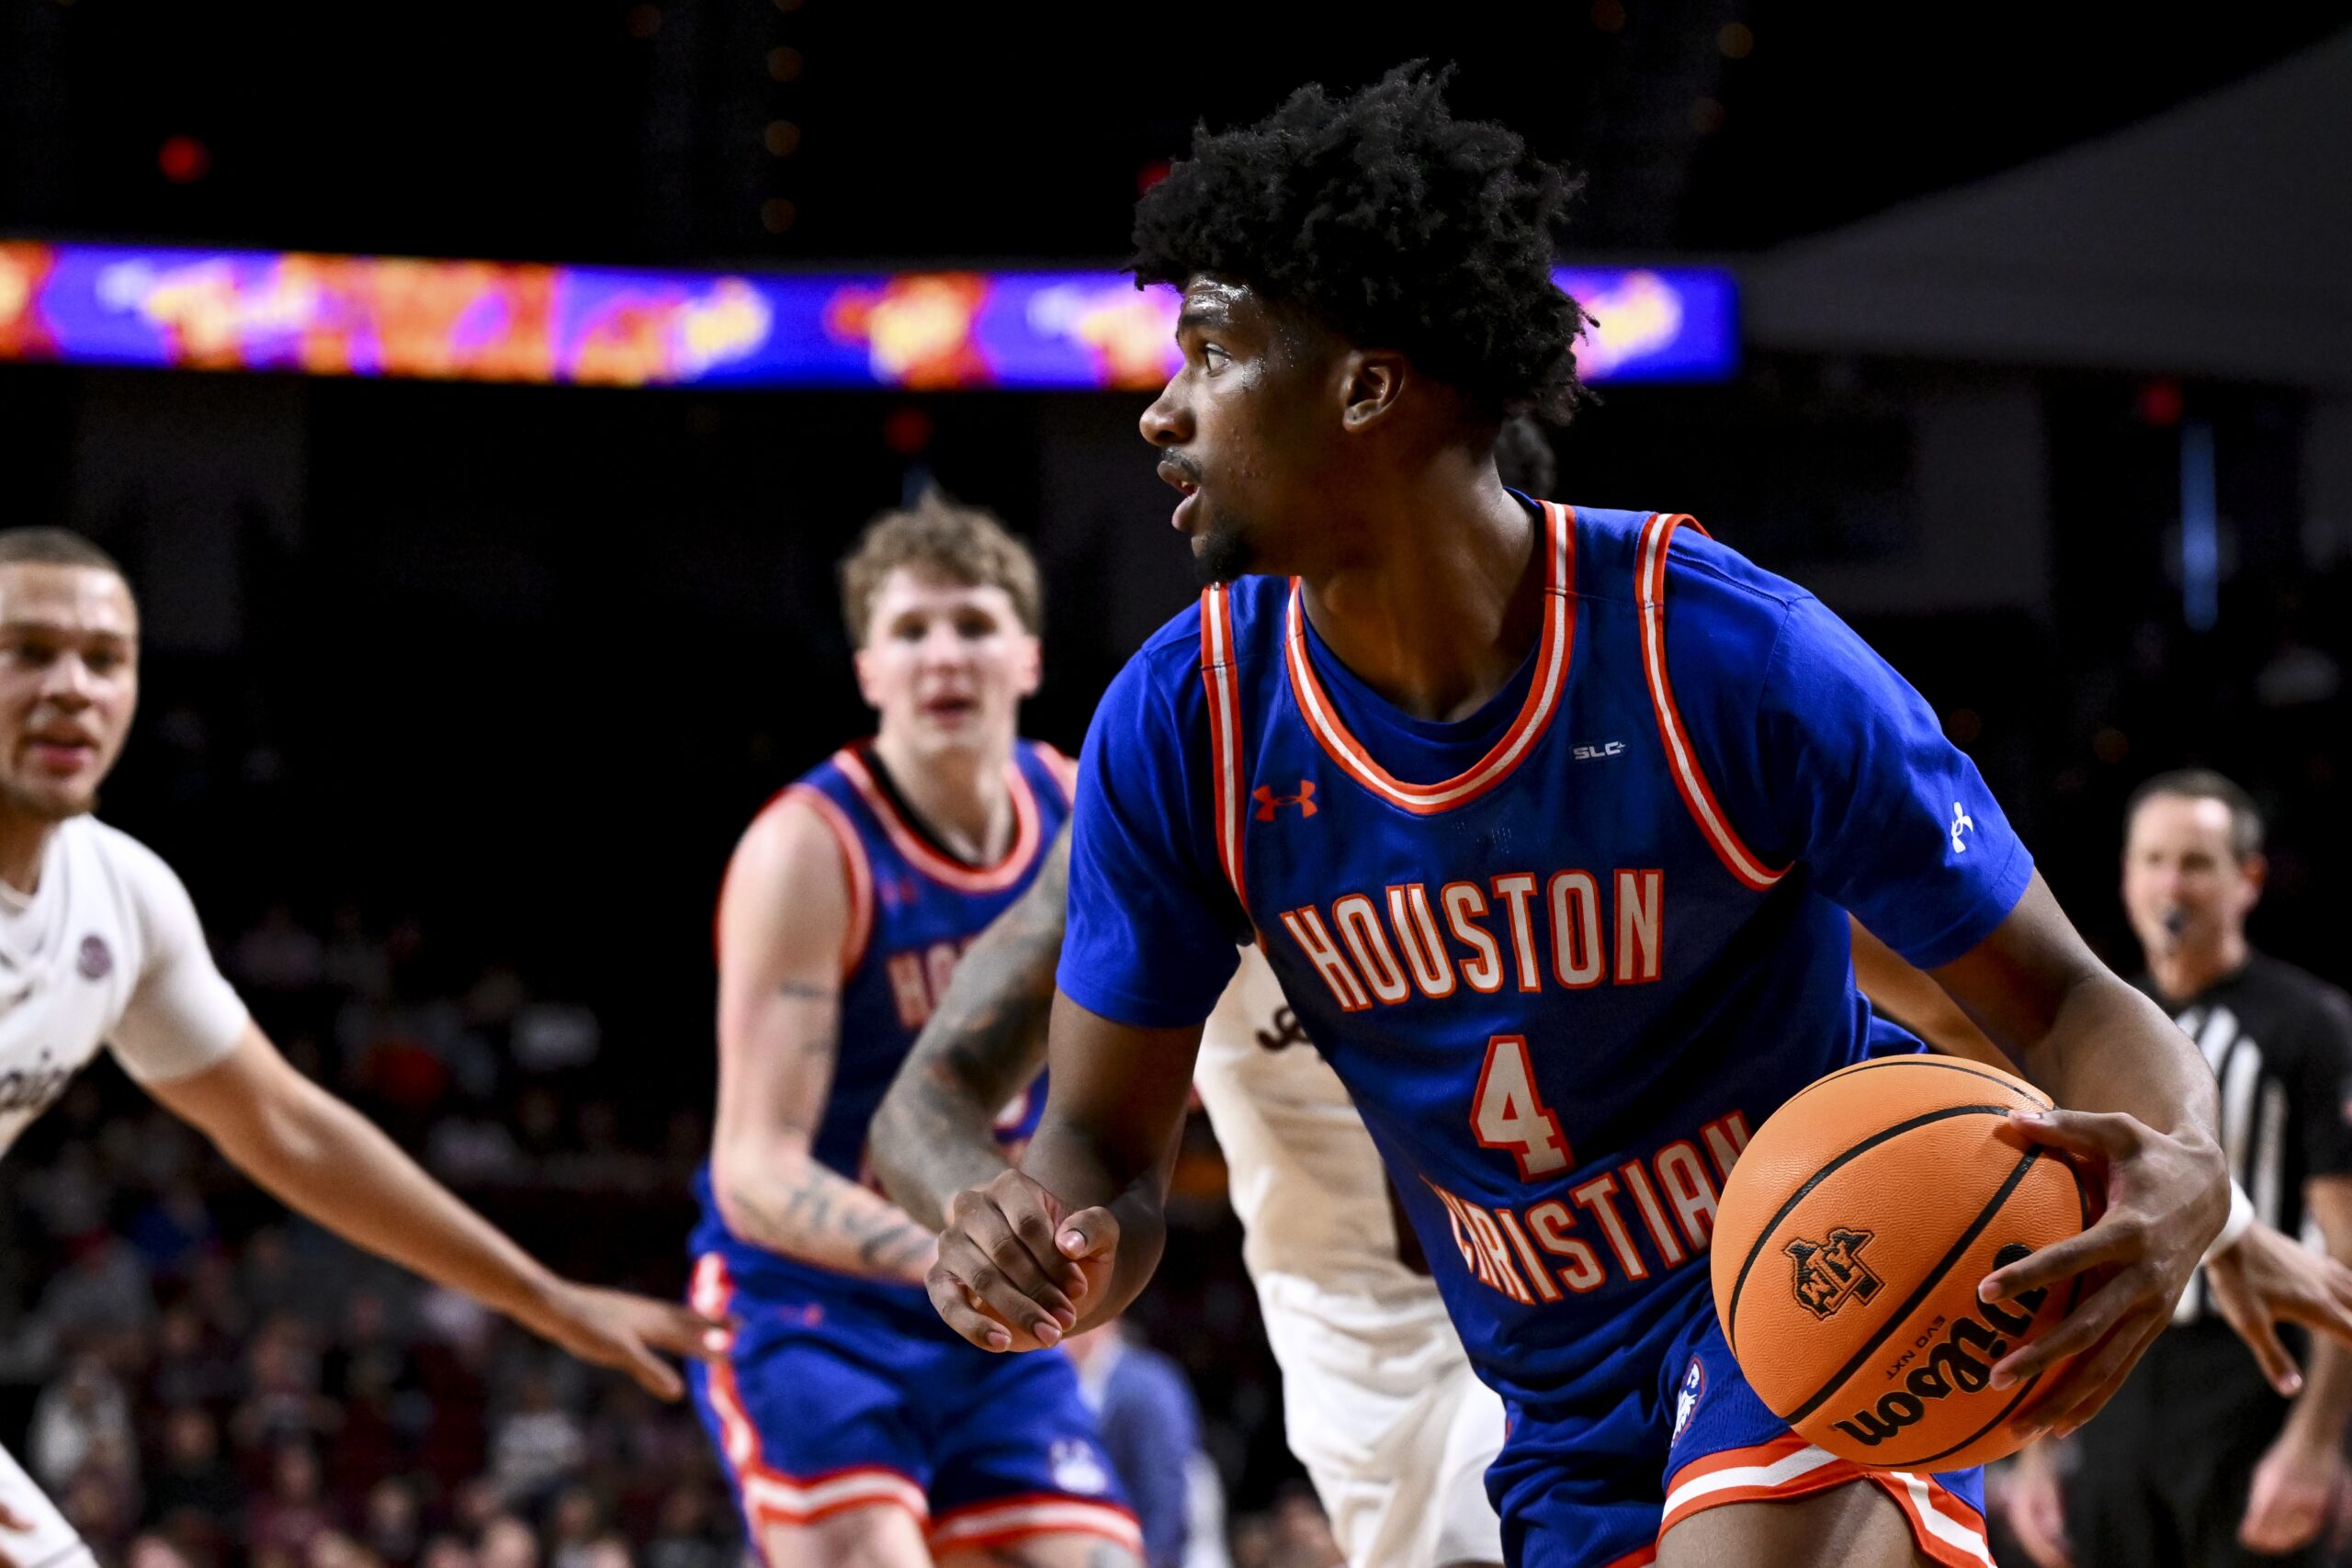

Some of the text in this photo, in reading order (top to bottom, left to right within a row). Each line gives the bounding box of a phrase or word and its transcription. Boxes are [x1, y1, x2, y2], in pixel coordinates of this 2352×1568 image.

[1573, 741, 1622, 761] SLC
[1280, 868, 1664, 1011] HOUSTON
[1471, 1034, 1573, 1184] 4
[1885, 1314, 1946, 1381] EVO NXT
